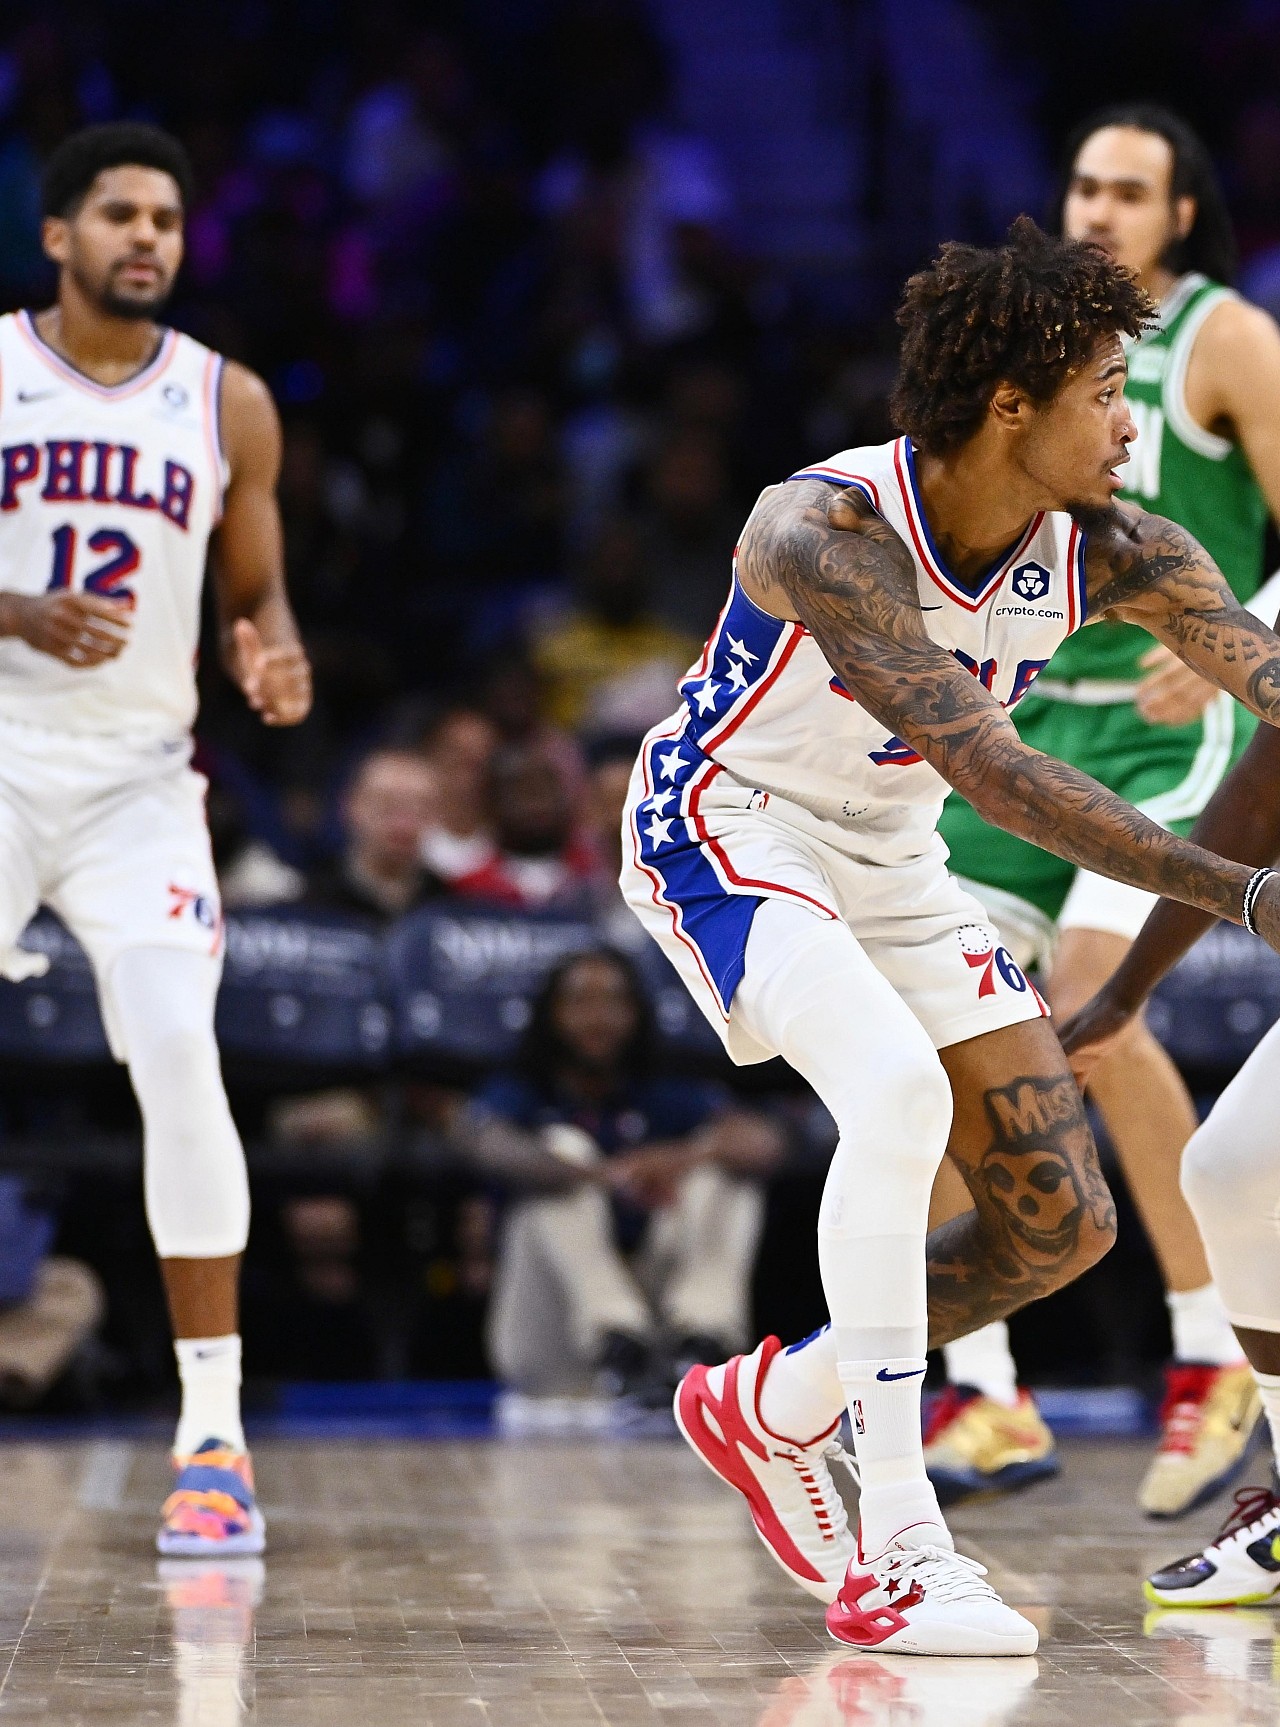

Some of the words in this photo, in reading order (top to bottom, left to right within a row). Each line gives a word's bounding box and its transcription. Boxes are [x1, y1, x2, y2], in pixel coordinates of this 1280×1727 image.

[0, 440, 194, 531] PHILA
[47, 523, 141, 611] 12
[995, 605, 1064, 620] crypto.com
[962, 946, 1027, 1000] 76
